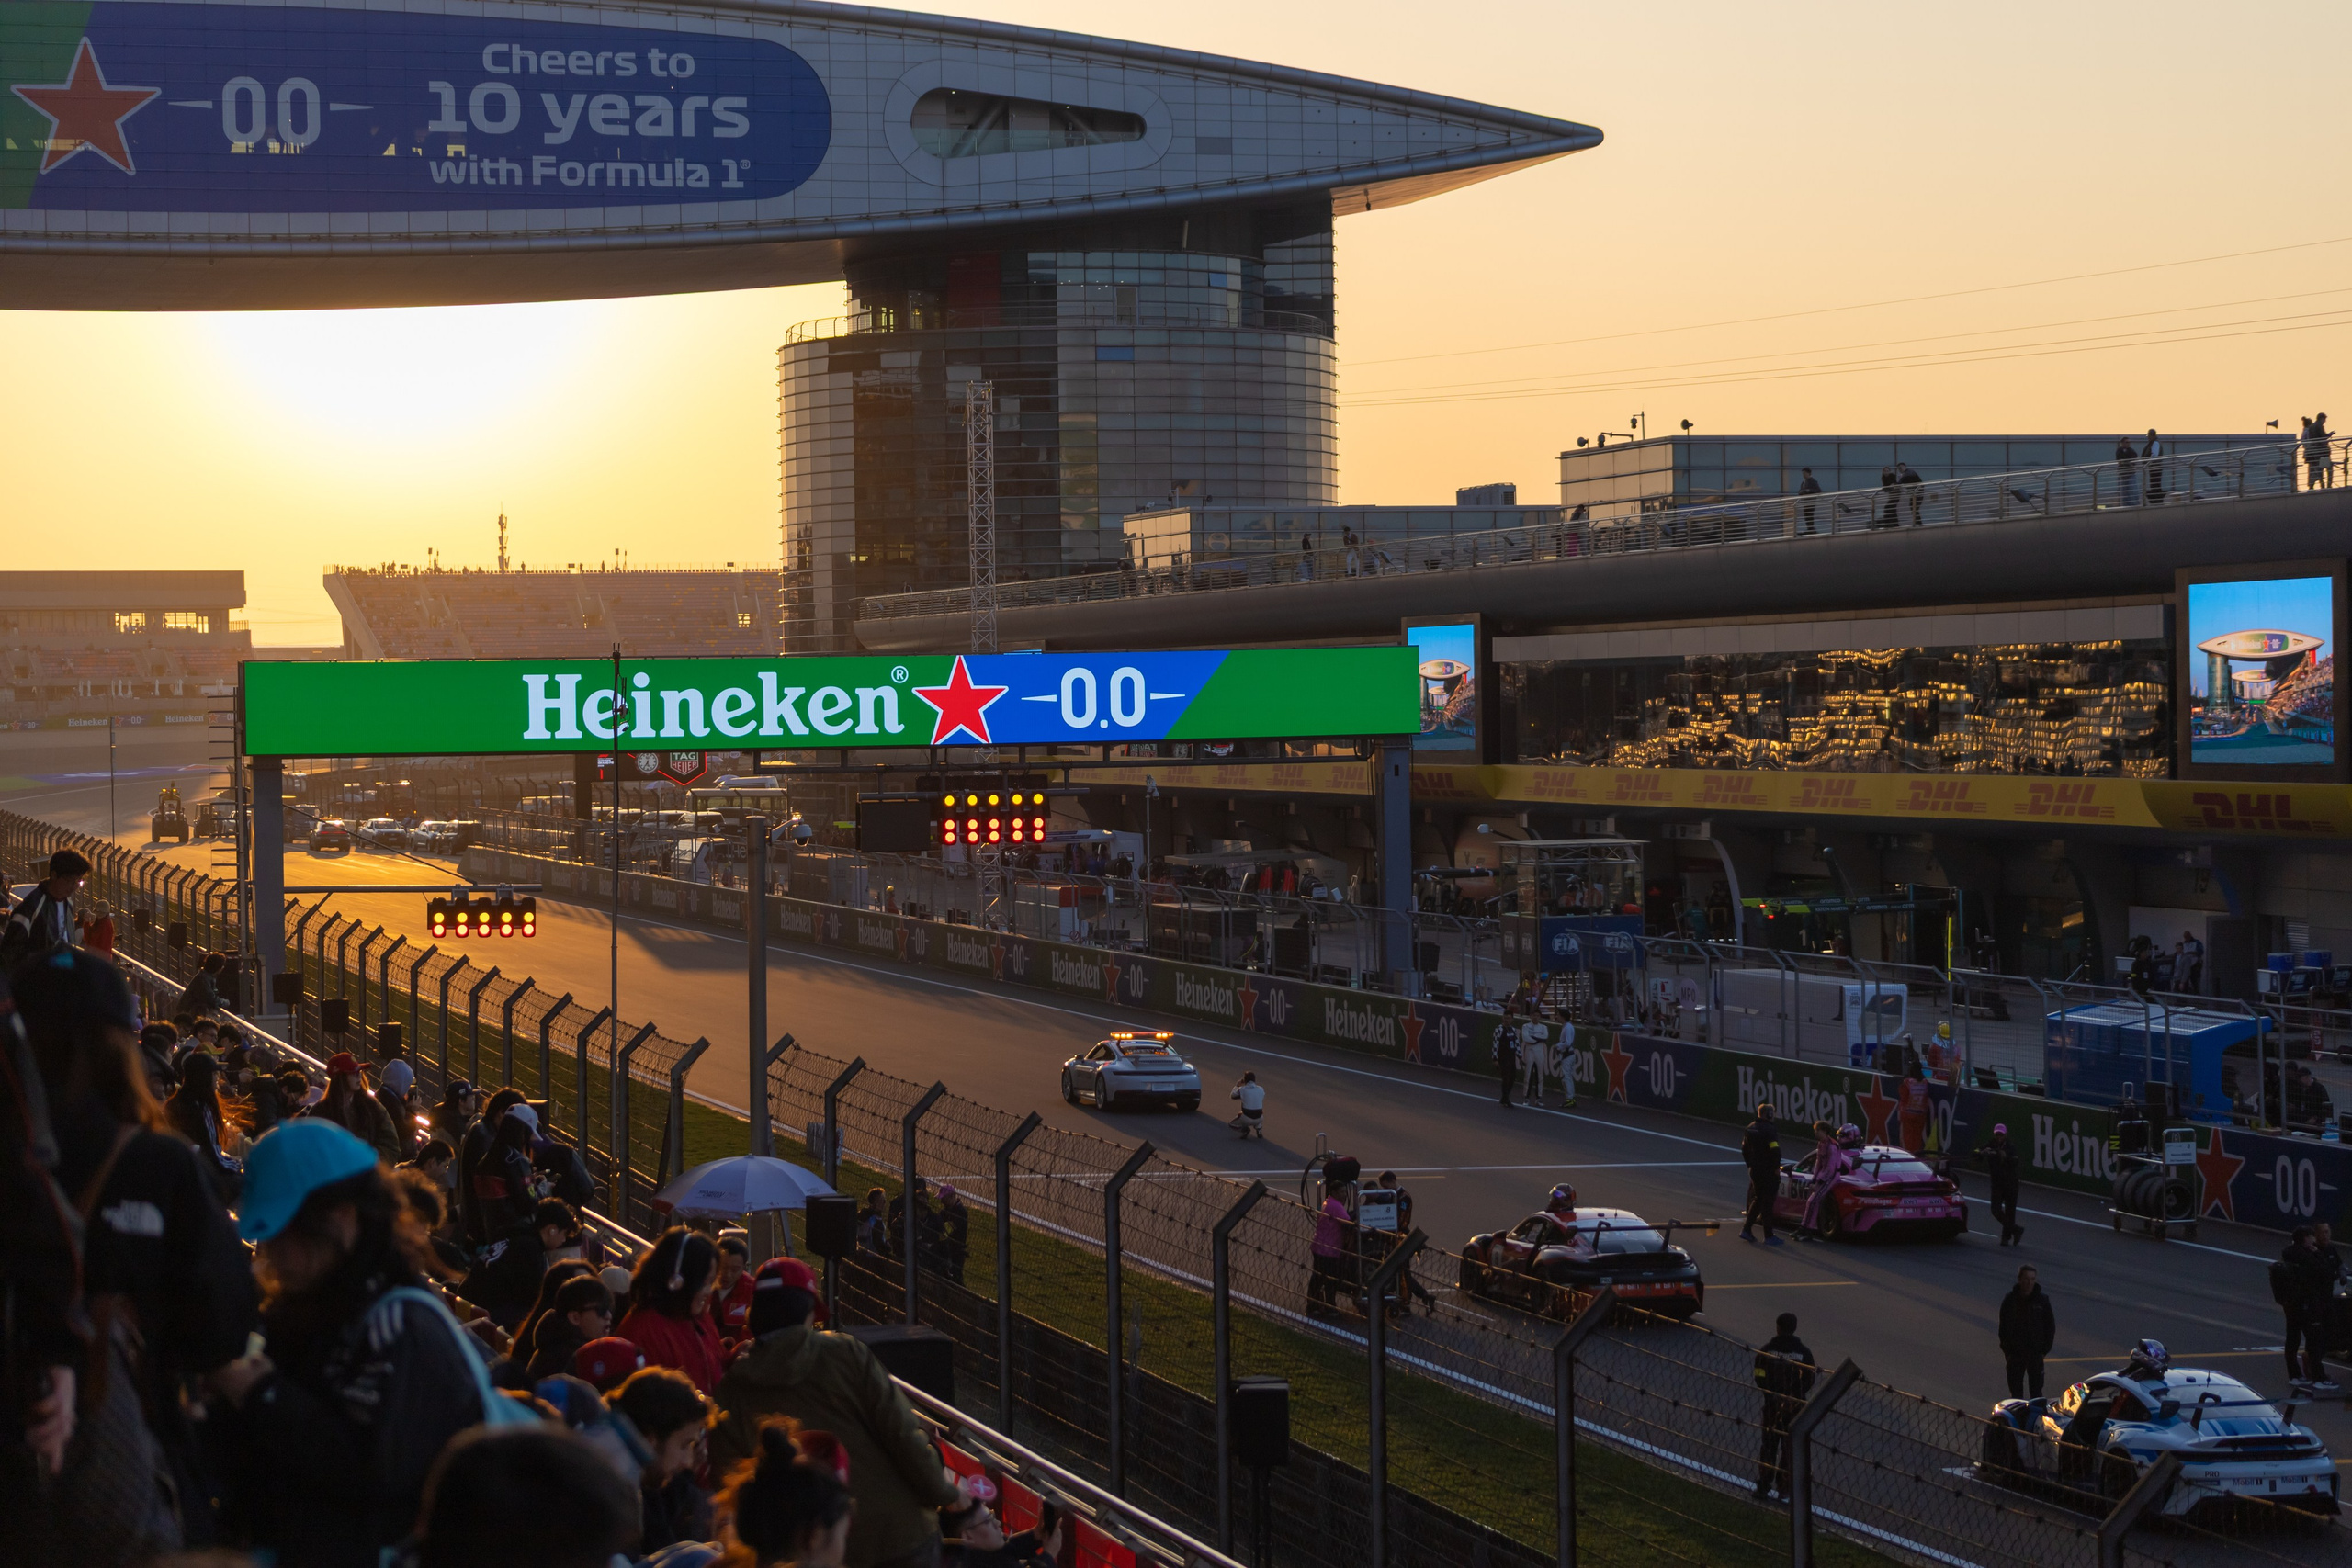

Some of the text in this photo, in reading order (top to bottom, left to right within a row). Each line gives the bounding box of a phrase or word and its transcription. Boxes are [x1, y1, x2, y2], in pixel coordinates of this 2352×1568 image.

[482, 43, 695, 78] Cheers to
[428, 81, 750, 145] 10 years
[429, 154, 744, 188] with Formula 1
[165, 714, 204, 723] Heineken
[522, 667, 1147, 739] Heineken 0.0
[68, 717, 107, 727] Heineken
[672, 761, 698, 775] HEUER
[673, 751, 697, 760] TAG
[1272, 764, 1306, 787] DHL
[1412, 773, 1464, 797] DHL
[1533, 772, 1579, 798] DHL
[1616, 774, 1667, 802] DHL
[1703, 775, 1758, 805] DHL
[1800, 778, 1864, 809] DHL
[1908, 780, 1977, 813] DHL
[2028, 783, 2102, 818] DHL
[2193, 792, 2313, 832] DHL
[780, 904, 811, 936] Heineken
[858, 916, 894, 951] Heineken
[947, 932, 988, 970] Heineken
[1051, 950, 1143, 998] Heineken 0.0
[1176, 972, 1286, 1026] Heineken 0.0
[1680, 987, 1696, 1001] MPO
[1324, 997, 1396, 1046] Heineken
[1439, 1015, 1459, 1058] 0.0
[1650, 1050, 1675, 1099] 0.0
[1736, 1065, 1848, 1130] Heineken
[2031, 1113, 2316, 1218] Heine 0.0
[2233, 1477, 2255, 1486] Mobil
[2281, 1475, 2301, 1484] Mobil
